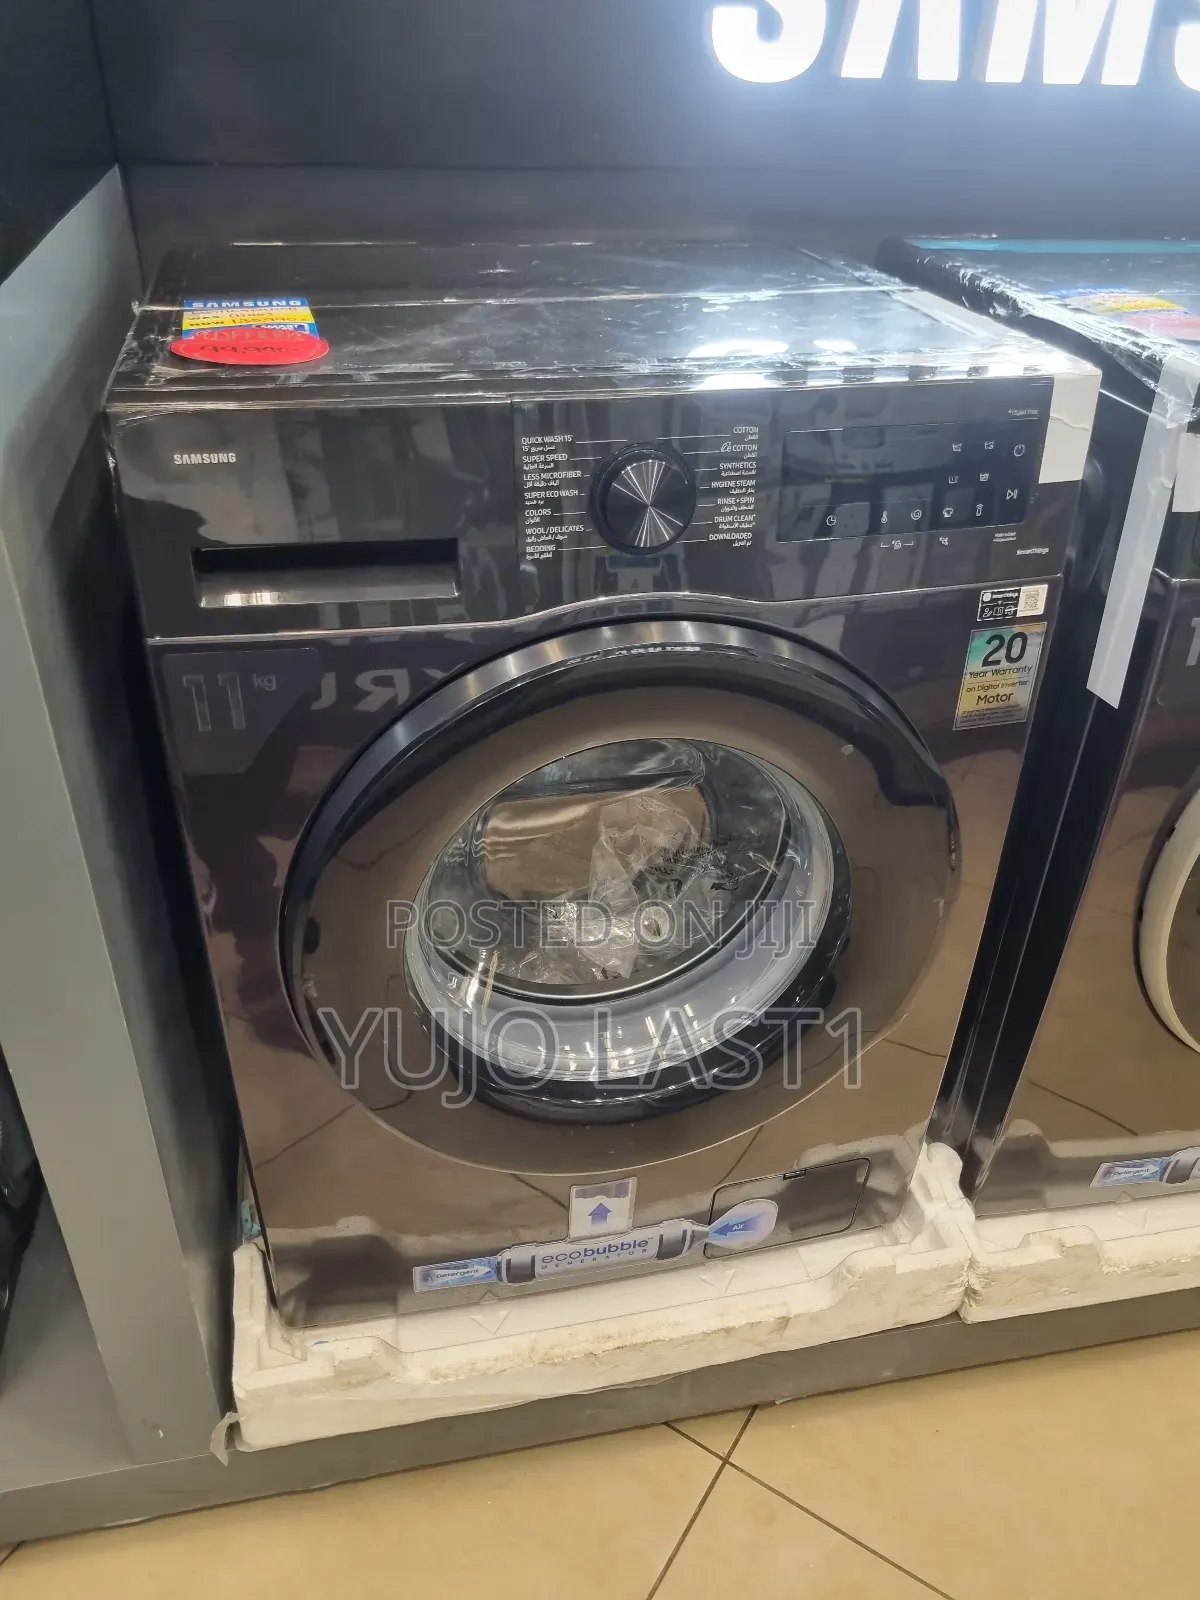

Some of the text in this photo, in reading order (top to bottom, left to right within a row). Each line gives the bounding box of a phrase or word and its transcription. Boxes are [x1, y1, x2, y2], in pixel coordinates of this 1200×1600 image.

[192, 300, 301, 308] SAMSUNG
[733, 426, 759, 434] COTTON
[521, 437, 543, 445] QUICK
[543, 435, 564, 443] WASH
[732, 444, 758, 452] COTTON
[173, 452, 237, 465] SAMSUNG
[522, 453, 568, 463] SUPER SPEED
[719, 461, 757, 470] SYNTHETICS
[523, 470, 582, 481] LESS MICROFIBER
[711, 479, 756, 489] HYGIENE STEAM
[524, 489, 579, 499] SUPER ECO WASH
[717, 496, 755, 505] RINSE+SPIN
[525, 508, 552, 517] COLORS
[525, 524, 585, 535] WOOL/DELICATES
[709, 532, 752, 541] DOWNLOADED
[526, 544, 556, 553] BEDDING
[981, 631, 1028, 668] 20
[968, 665, 1034, 680] Year Warranty
[977, 682, 1000, 693] Digital
[182, 673, 246, 732] 11
[252, 674, 277, 691] kg
[976, 692, 1015, 706] Motor
[732, 1222, 746, 1233] Air
[436, 1268, 479, 1279] Detergent
